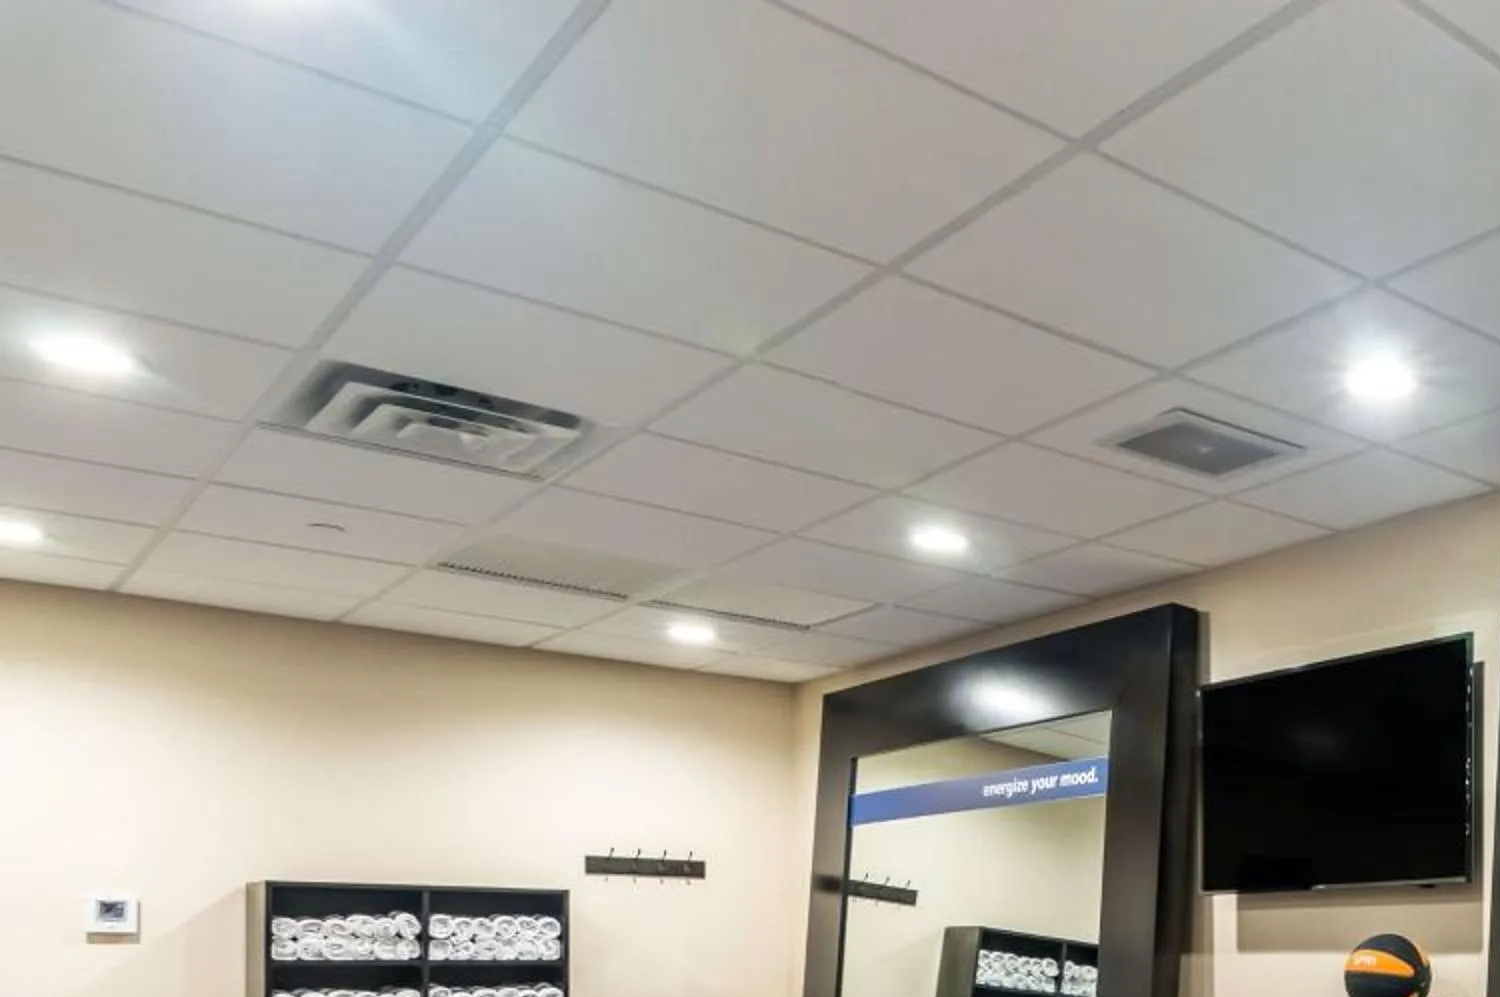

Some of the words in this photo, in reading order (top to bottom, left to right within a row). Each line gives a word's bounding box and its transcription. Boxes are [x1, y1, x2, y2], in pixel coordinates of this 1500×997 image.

[983, 776, 1029, 798] energize
[1031, 775, 1058, 795] your
[1060, 765, 1099, 786] mood.
